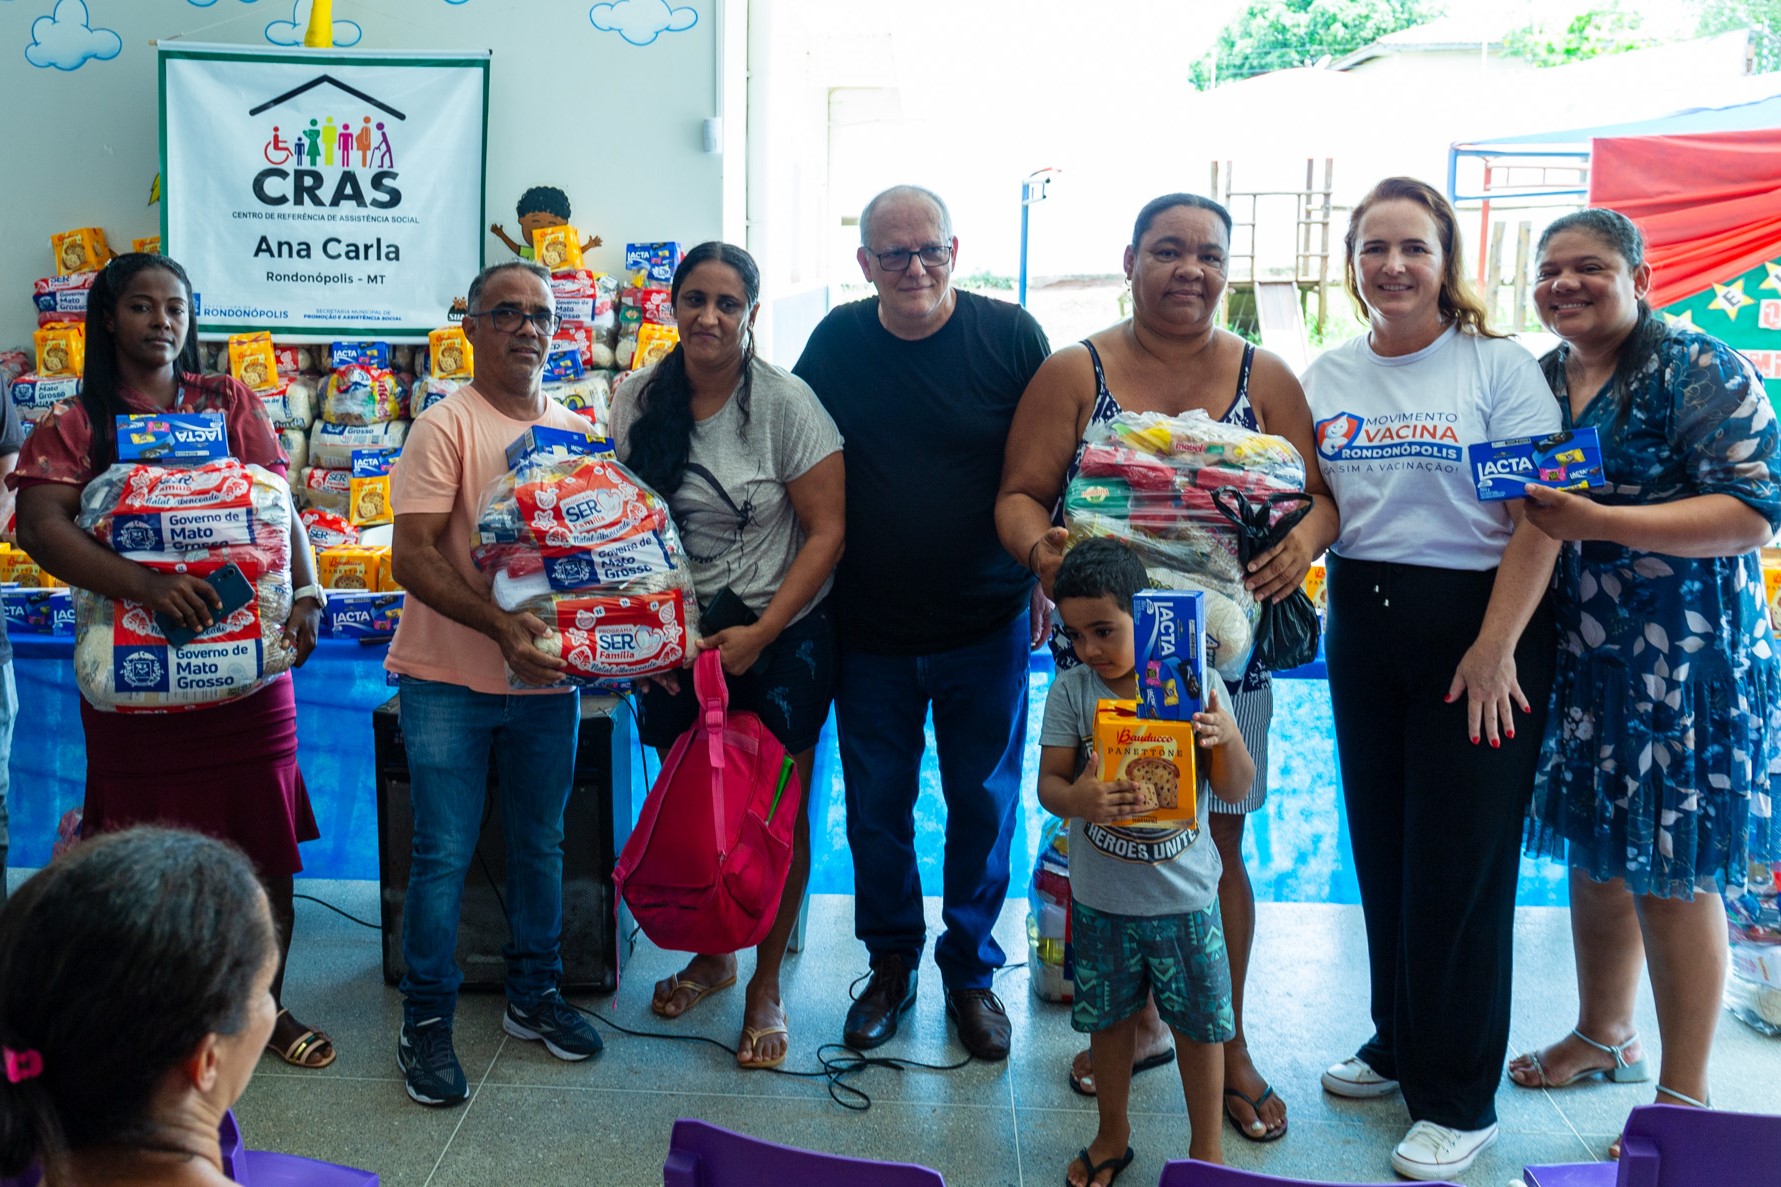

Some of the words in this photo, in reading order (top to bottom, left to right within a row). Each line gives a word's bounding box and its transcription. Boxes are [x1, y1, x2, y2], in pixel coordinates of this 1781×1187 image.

[252, 168, 402, 209] CRAS
[232, 211, 263, 220] CENTRO
[265, 212, 274, 220] DE
[277, 212, 325, 221] REFERÊNCIA
[339, 213, 389, 223] ASSISTÊNCIA
[391, 216, 420, 224] SOCIAL
[253, 235, 311, 259] Ana
[322, 237, 400, 262] Carla
[627, 251, 650, 260] LACTA
[266, 271, 354, 285] Rondonópolis
[367, 275, 386, 285] MT
[204, 307, 289, 319] RONDONÓPOLIS
[333, 350, 357, 361] LACTA
[39, 391, 66, 399] Grosso
[1365, 412, 1458, 426] MOVIMENTO
[174, 428, 223, 443] LACTA
[1364, 424, 1460, 443] VACINA
[1341, 443, 1457, 459] RONDONÓPOLIS
[354, 458, 379, 468] LACTA
[1339, 465, 1361, 473] SIM
[1379, 461, 1459, 474] VACINAÇÃO!
[1477, 457, 1533, 481] LACTA
[328, 472, 347, 482] SER
[566, 499, 602, 523] SER
[169, 515, 222, 526] Governo
[225, 511, 239, 522] de
[171, 527, 213, 540] Mato
[310, 528, 328, 539] SER
[172, 540, 229, 551] Grosso
[598, 541, 638, 558] Governo
[639, 536, 652, 547] de
[601, 556, 636, 568] Mato
[605, 564, 652, 579] Grosso
[4, 605, 25, 617] CTA
[53, 609, 76, 624] LAC
[333, 611, 370, 624] LACTA
[1154, 601, 1176, 656] LACTA
[599, 633, 635, 650] SER
[176, 648, 229, 660] Governo
[233, 645, 248, 656] de
[176, 662, 218, 675] Mato
[590, 662, 613, 673] Natal
[177, 675, 234, 690] Grosso
[1117, 727, 1173, 745] Bauducco
[1107, 747, 1184, 757] PANETTONE
[1088, 823, 1149, 860] HEROES
